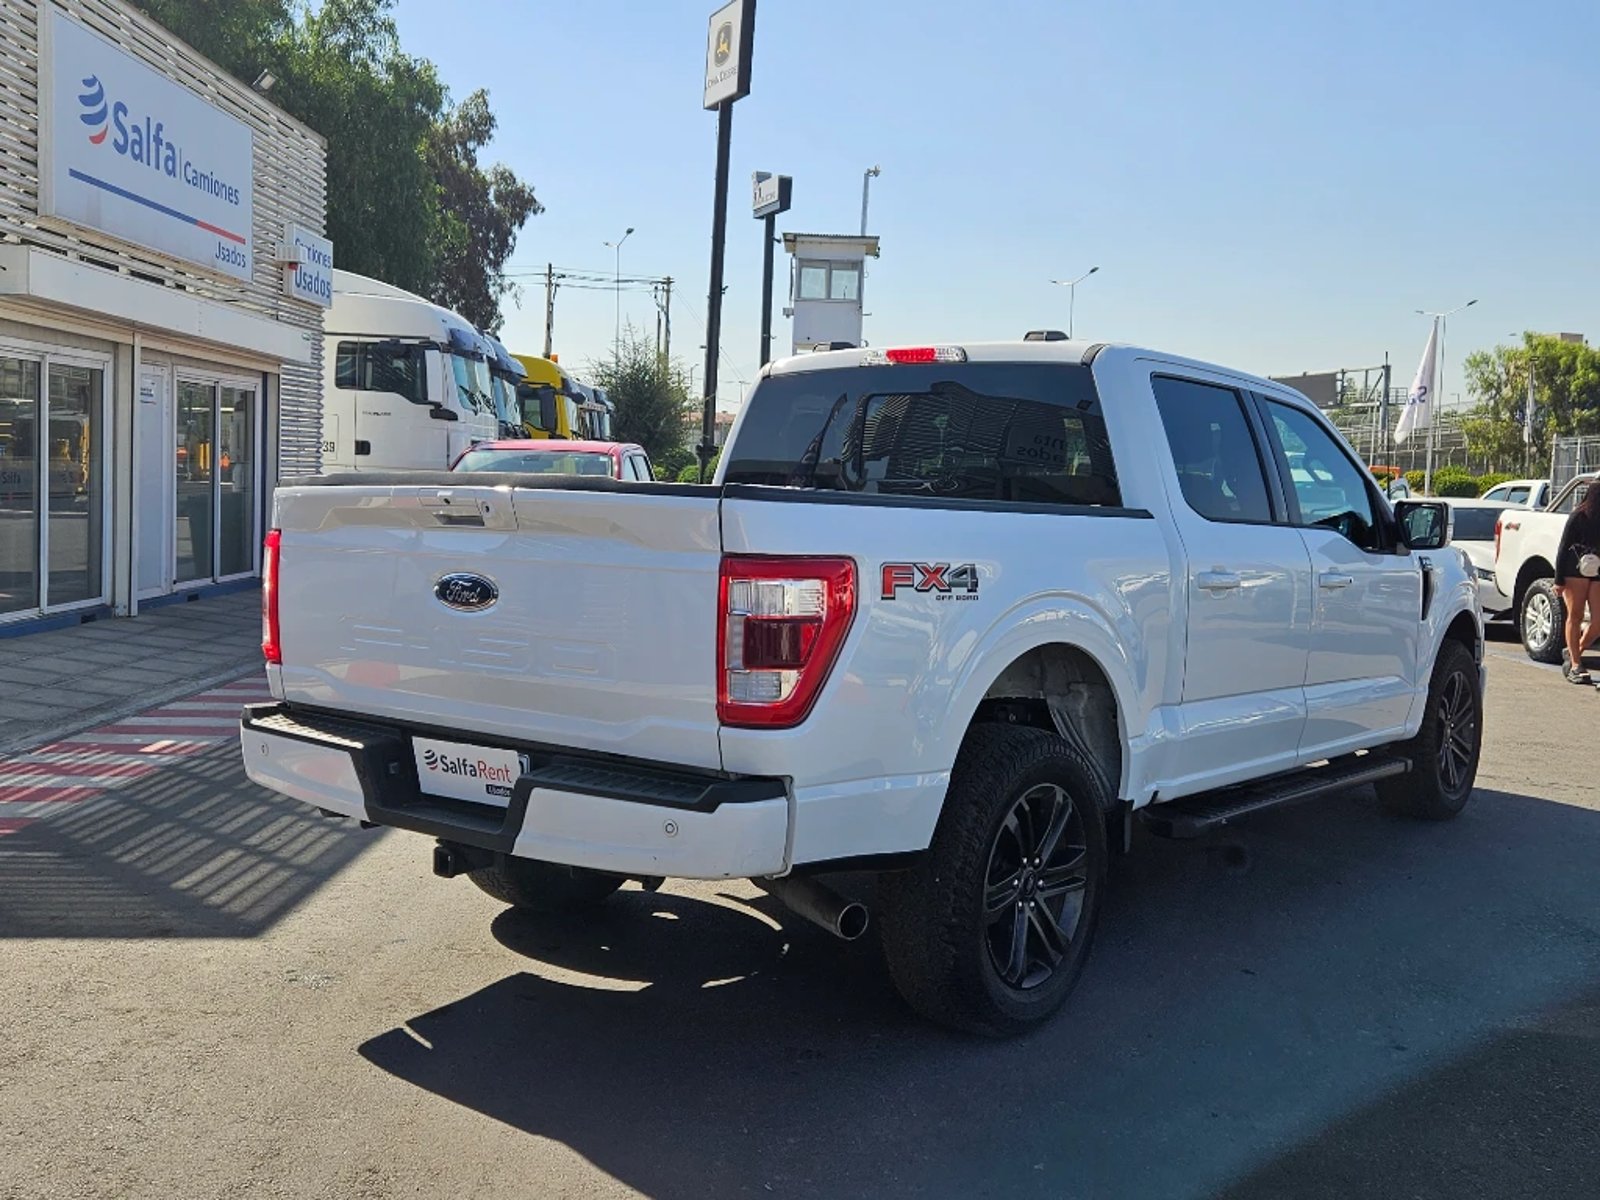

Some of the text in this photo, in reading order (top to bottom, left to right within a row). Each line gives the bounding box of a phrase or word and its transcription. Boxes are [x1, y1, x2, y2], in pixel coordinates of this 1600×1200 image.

[113, 101, 240, 206] Salfa Camiones
[295, 265, 331, 298] Usados
[446, 579, 481, 603] Ford
[880, 562, 979, 600] FX4
[440, 753, 512, 783] SalfaRent
